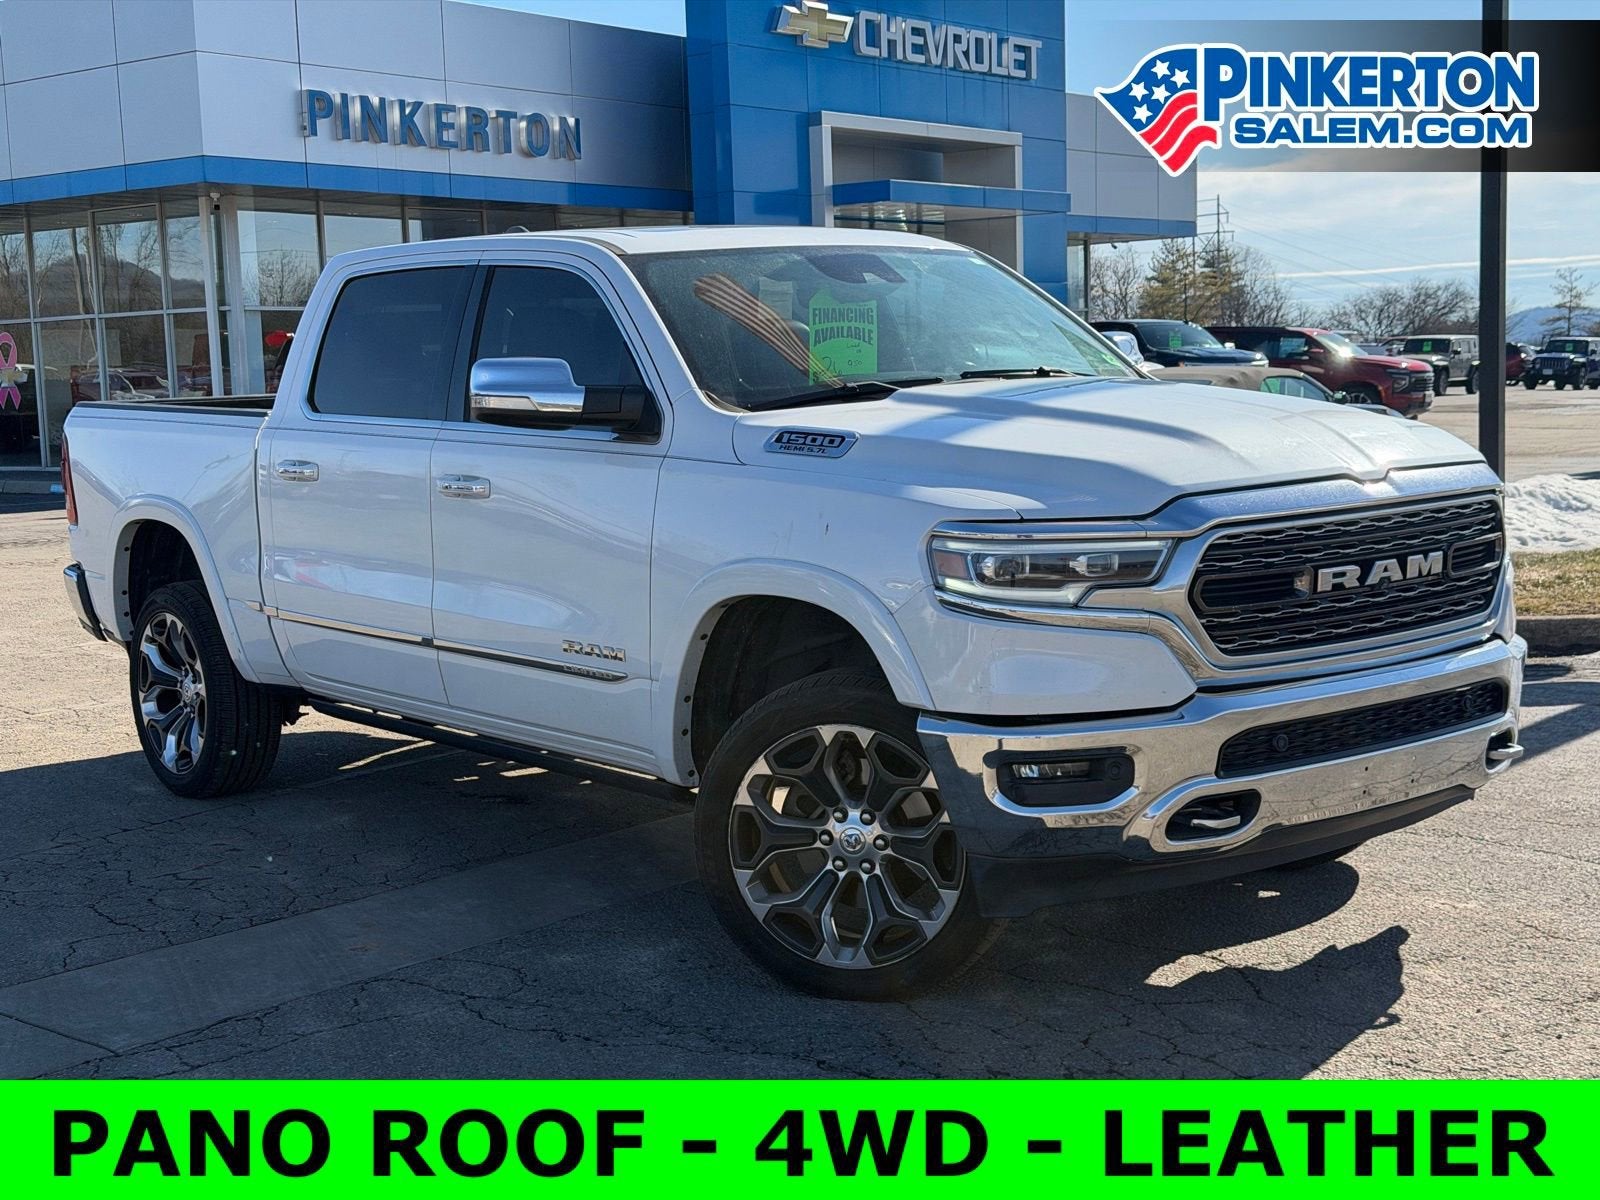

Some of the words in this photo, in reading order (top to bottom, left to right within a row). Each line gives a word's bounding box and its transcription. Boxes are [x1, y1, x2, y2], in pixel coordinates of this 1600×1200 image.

[853, 9, 1042, 80] CHEVROLET
[302, 88, 582, 160] PINKERTON
[812, 307, 874, 325] FINANCING
[813, 326, 874, 347] AVAILABLE
[779, 444, 805, 453] HEMI
[806, 446, 827, 454] 5.7L
[780, 433, 843, 448] 1500
[1317, 551, 1443, 593] RAM
[562, 639, 626, 662] RAM
